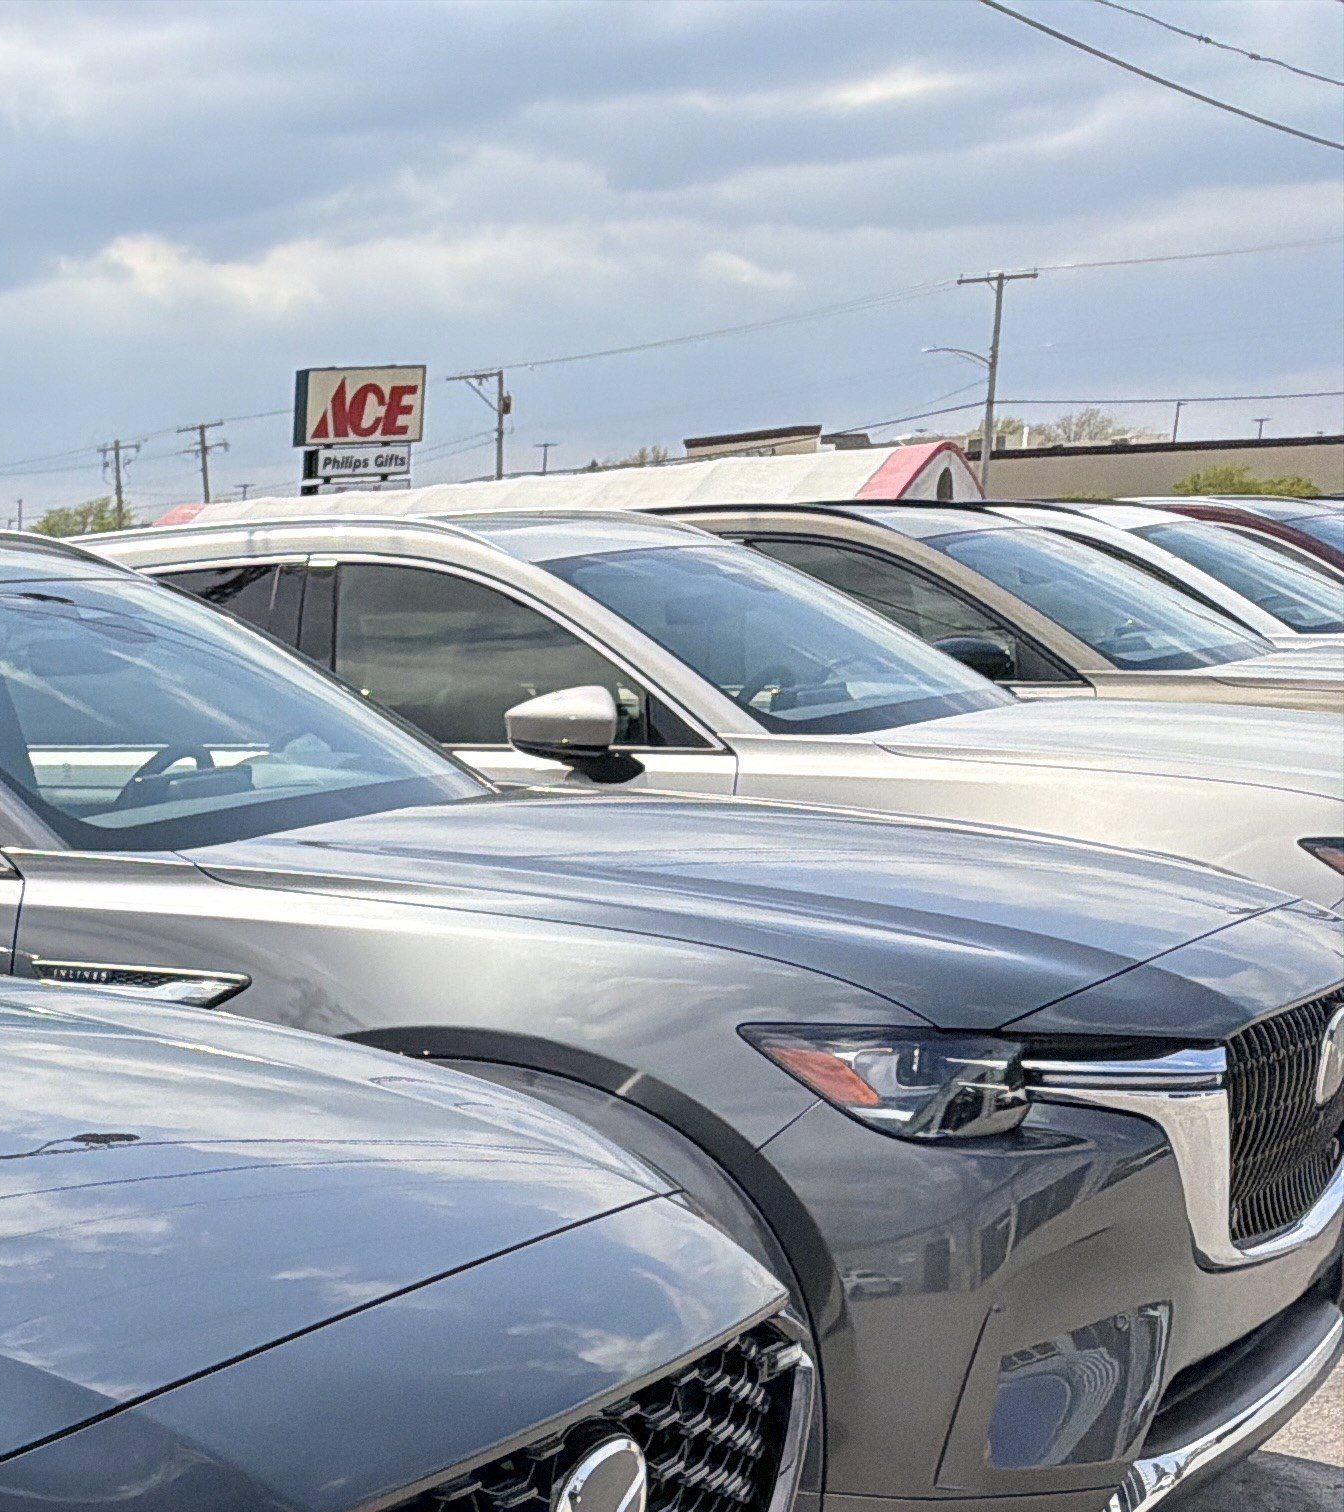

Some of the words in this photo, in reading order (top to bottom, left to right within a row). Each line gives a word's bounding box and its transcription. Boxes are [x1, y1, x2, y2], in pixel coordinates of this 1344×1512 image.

[310, 375, 418, 439] ACE
[322, 455, 369, 473] Philips
[374, 453, 407, 468] Gifts
